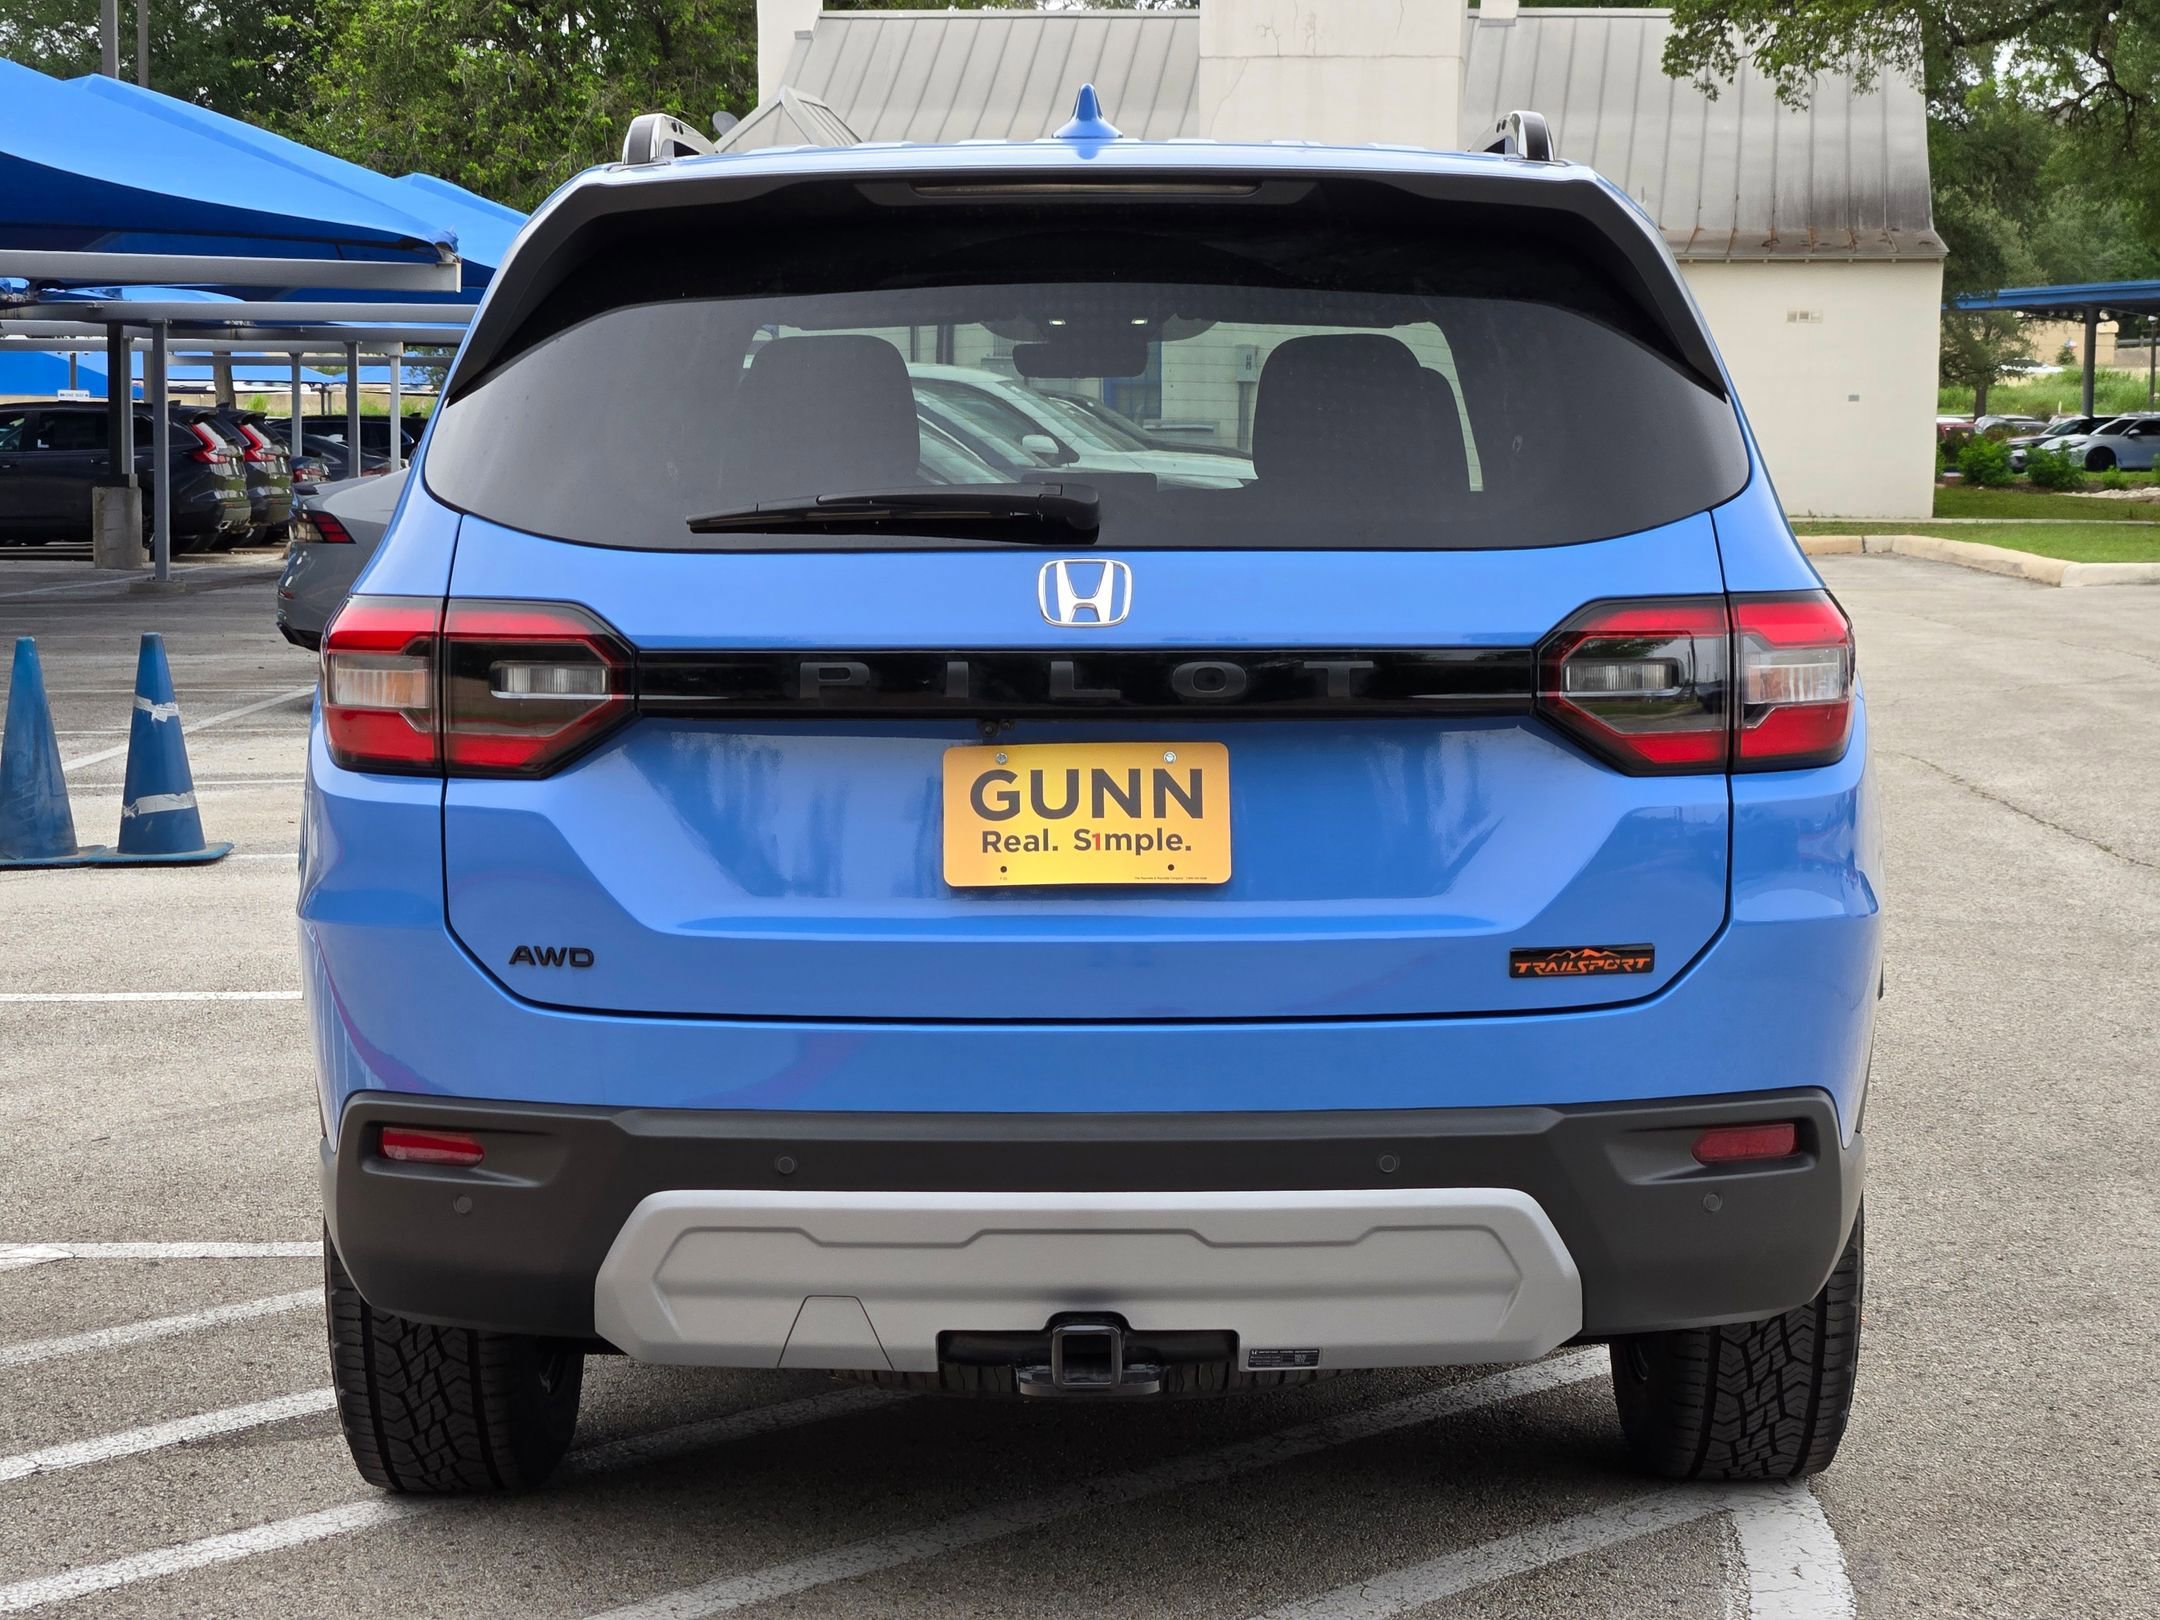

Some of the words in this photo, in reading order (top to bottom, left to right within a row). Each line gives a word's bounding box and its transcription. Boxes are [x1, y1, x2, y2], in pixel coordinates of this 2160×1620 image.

[799, 660, 1374, 700] PILOT
[969, 767, 1204, 822] GUNN
[981, 828, 1059, 854] Real.
[508, 945, 595, 968] AWD
[1514, 957, 1651, 976] TRAILSPORT
